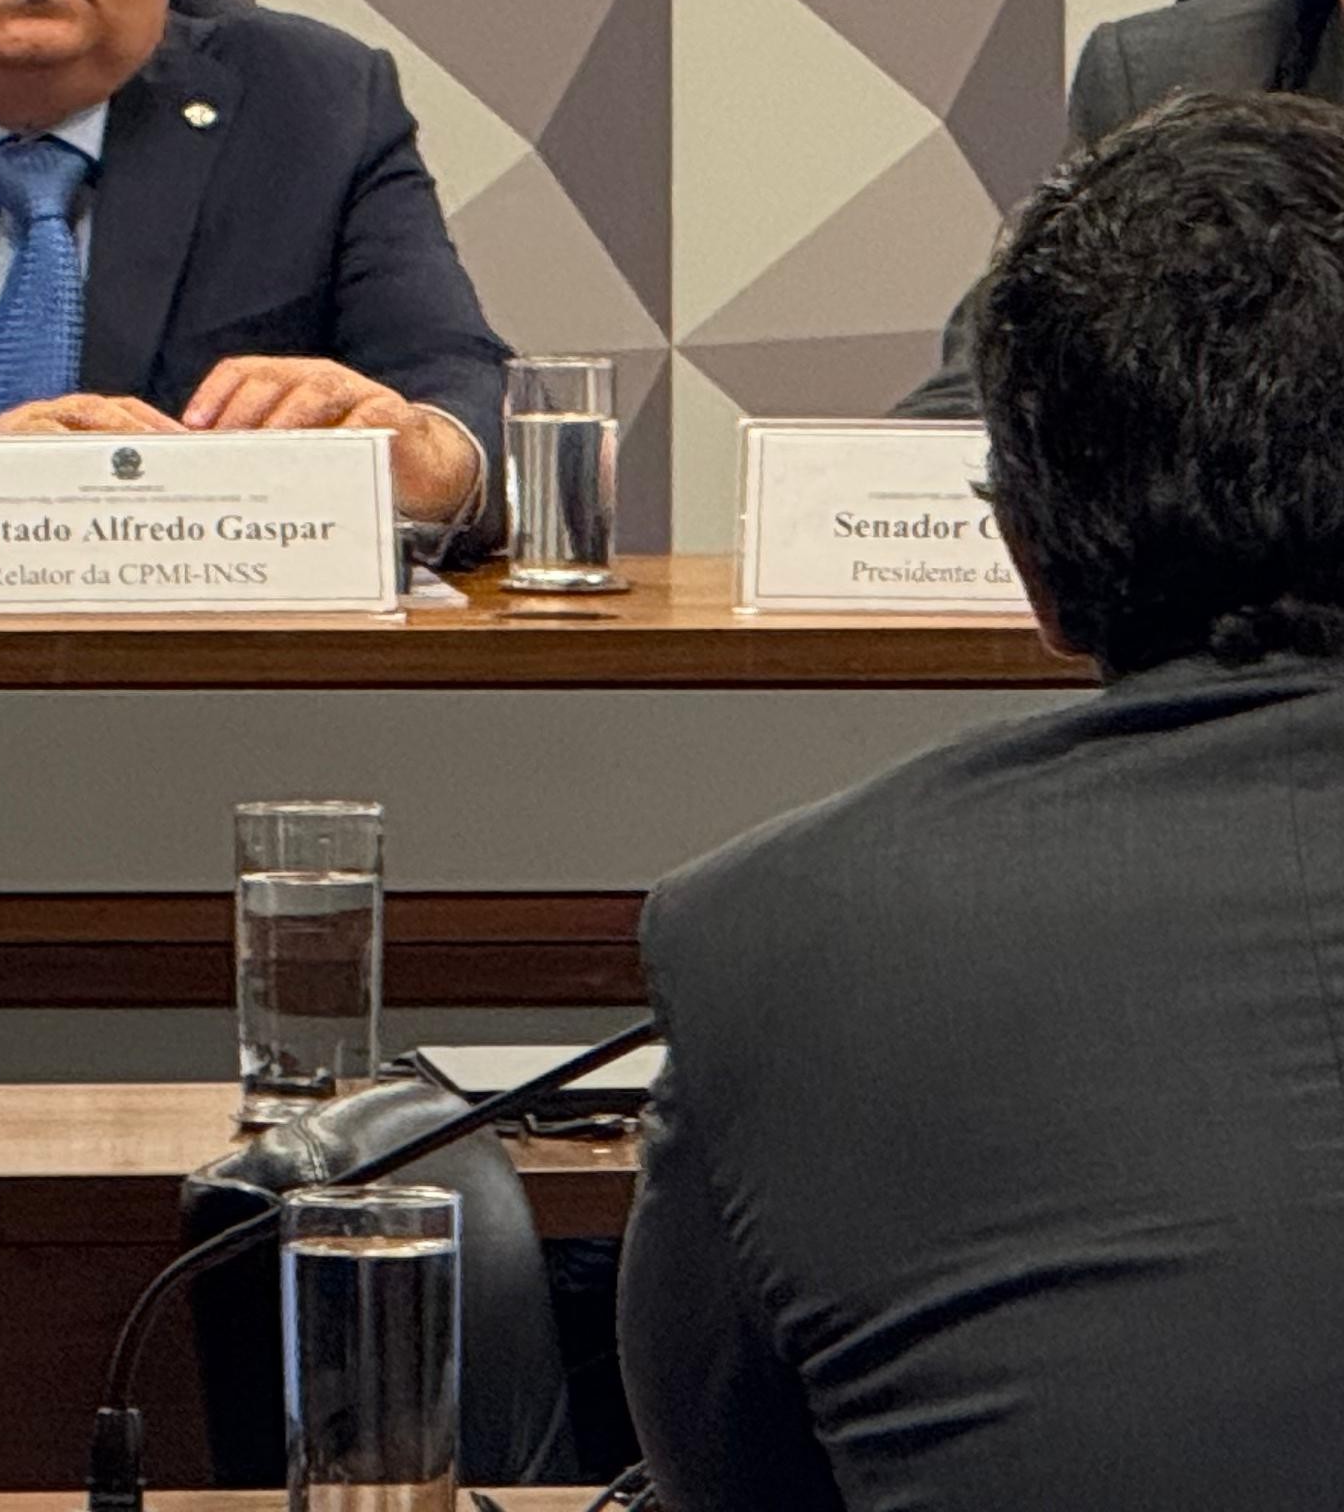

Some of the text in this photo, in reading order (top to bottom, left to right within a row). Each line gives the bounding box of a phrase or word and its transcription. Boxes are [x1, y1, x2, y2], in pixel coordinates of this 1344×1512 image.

[82, 515, 205, 541] Alfredo
[216, 514, 336, 548] Gaspar
[834, 511, 968, 539] Senador
[81, 563, 110, 585] da
[118, 562, 269, 586] CPMI-INSS
[851, 560, 1013, 584] Presidente da
